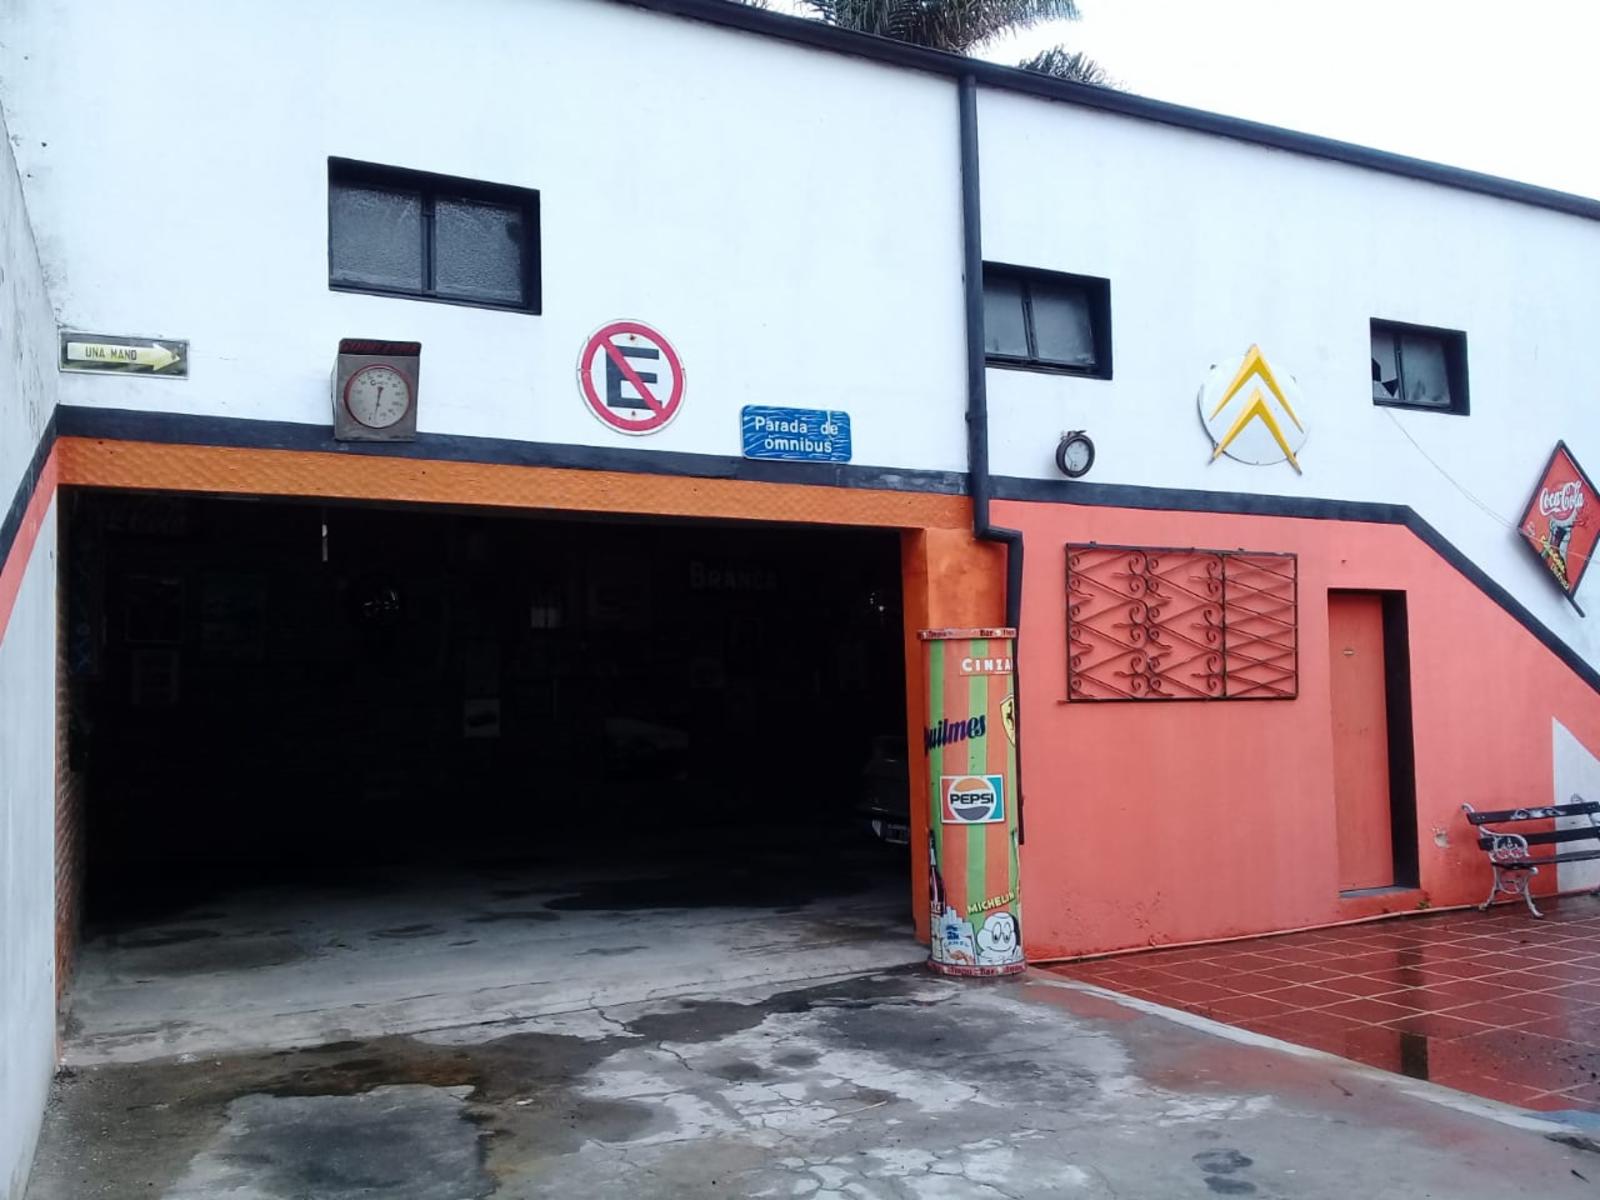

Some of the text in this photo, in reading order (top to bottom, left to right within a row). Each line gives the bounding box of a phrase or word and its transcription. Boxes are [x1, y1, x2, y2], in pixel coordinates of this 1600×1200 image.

[85, 346, 137, 361] UNA MANO
[605, 345, 663, 411] E
[754, 416, 839, 436] Parada de
[1540, 480, 1584, 516] Coca-Cola
[962, 658, 1013, 673] CINZA
[950, 792, 994, 805] PEPSI
